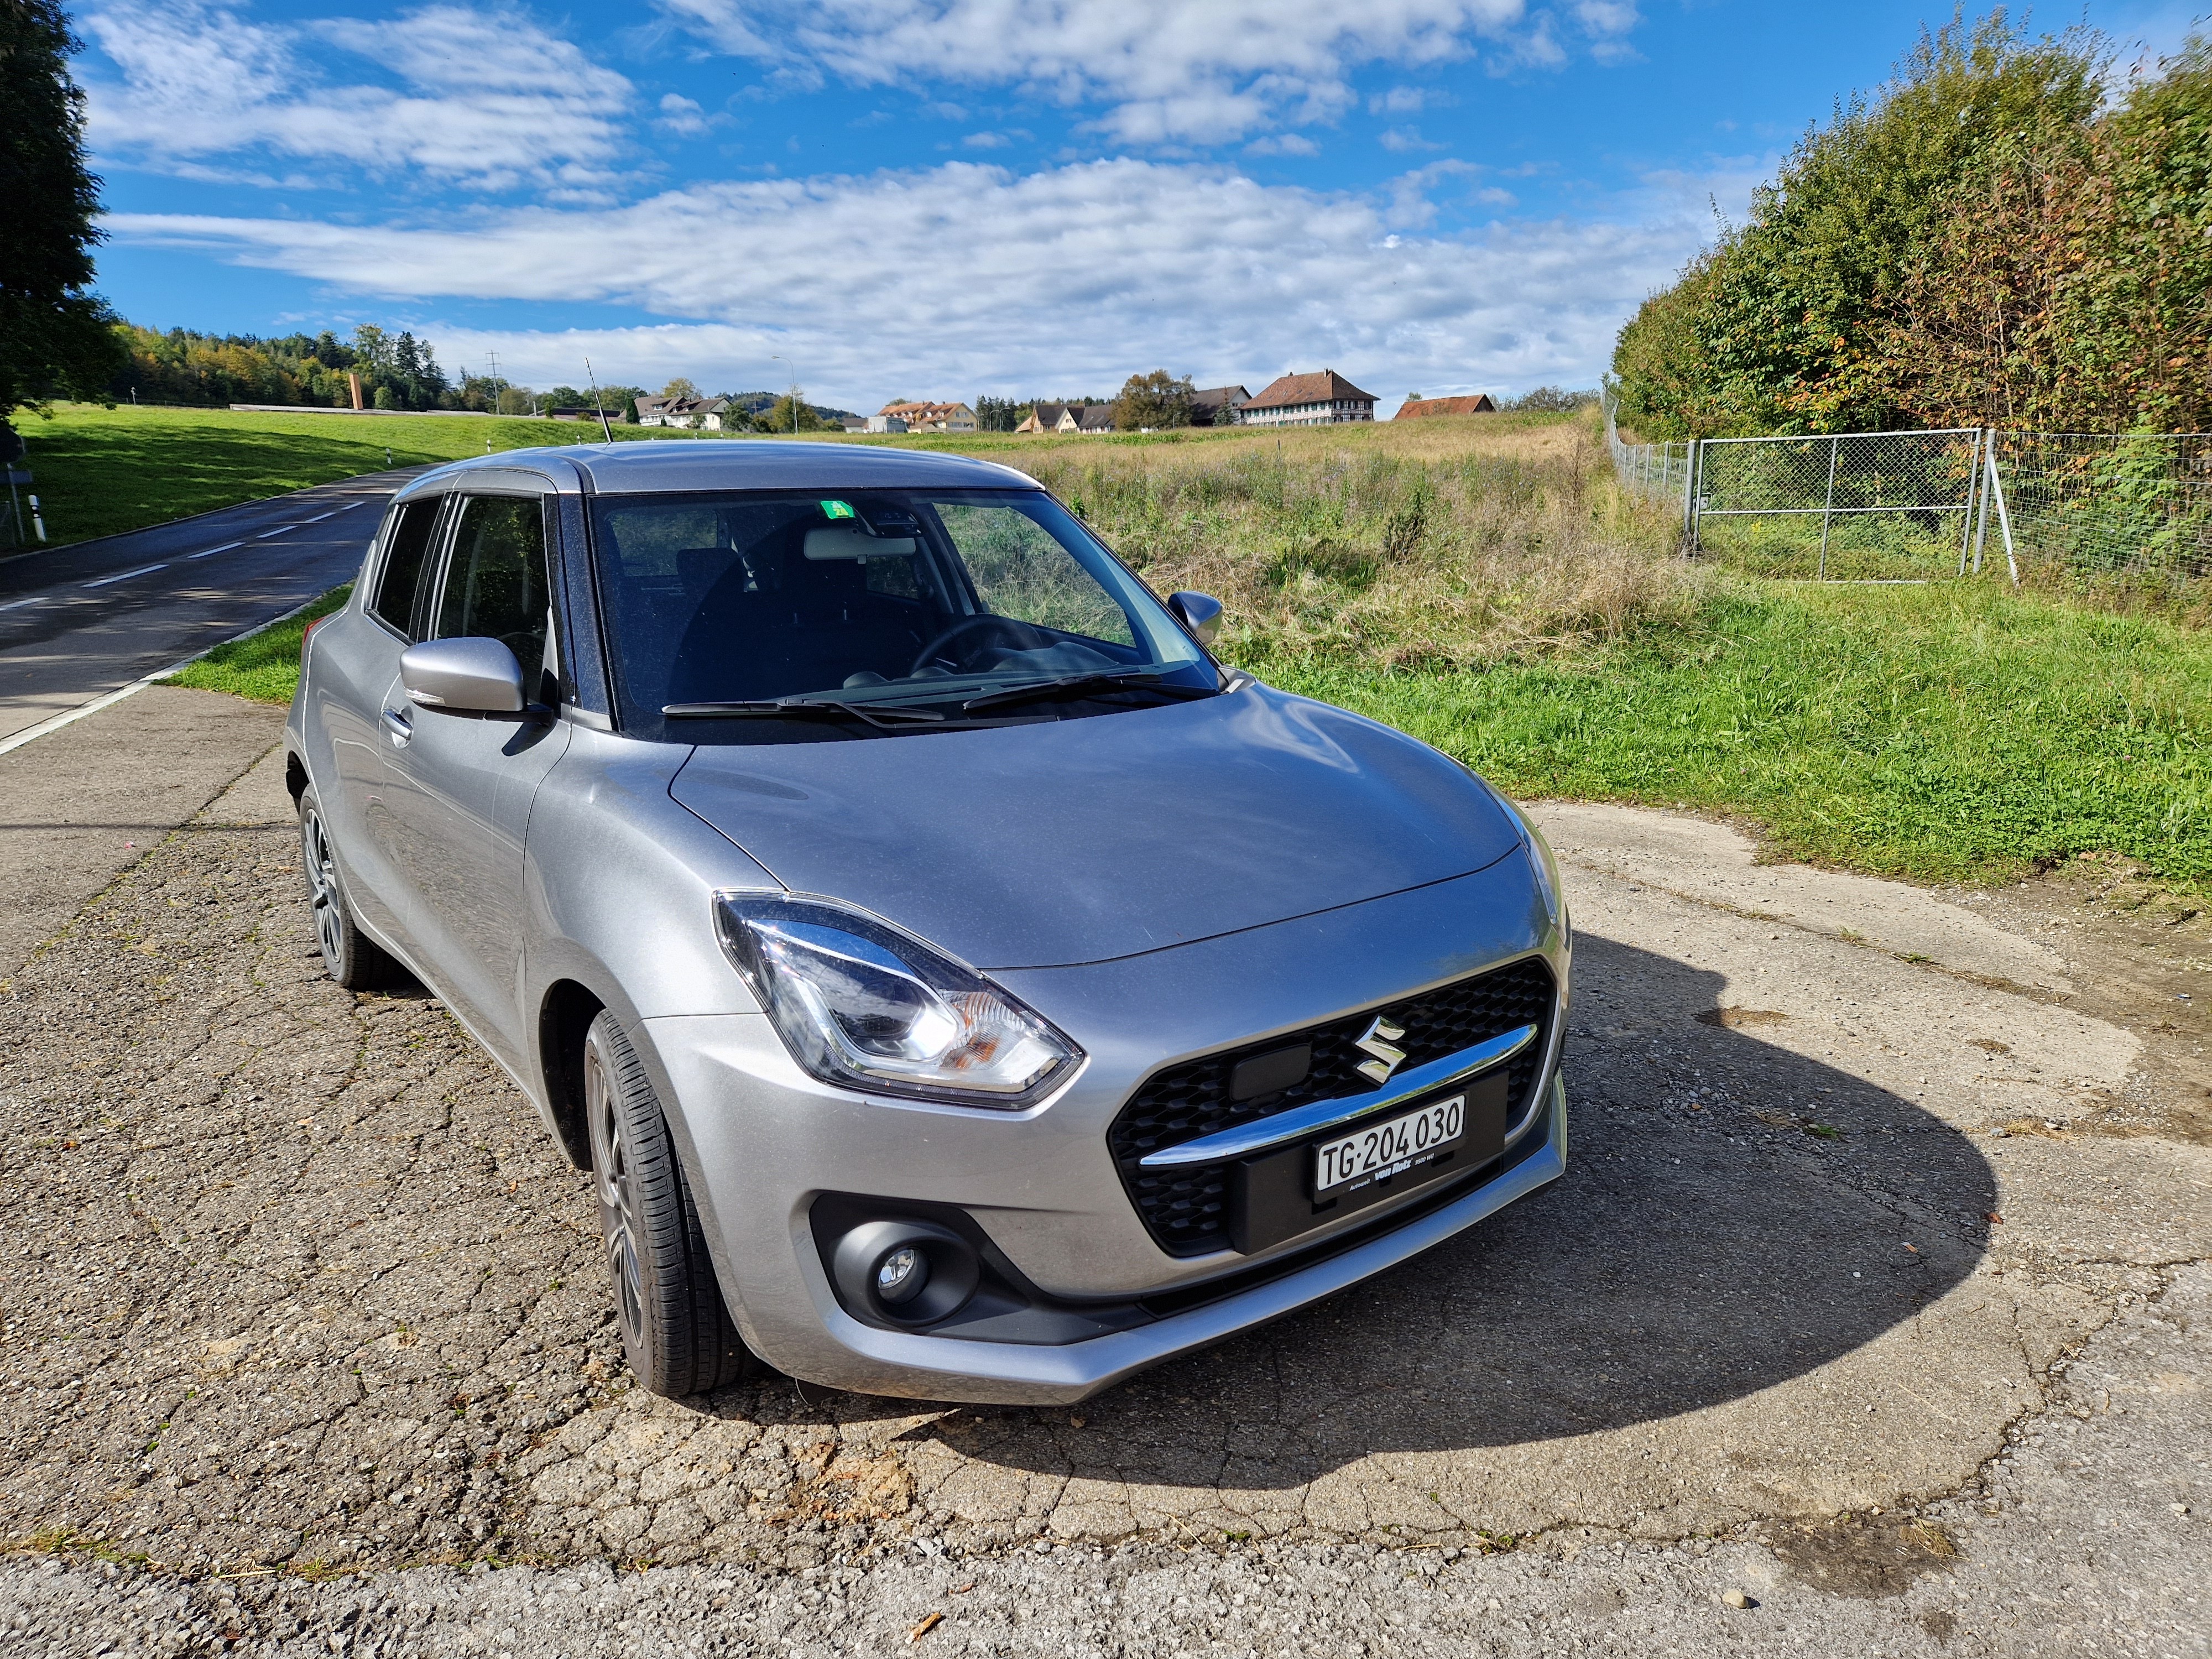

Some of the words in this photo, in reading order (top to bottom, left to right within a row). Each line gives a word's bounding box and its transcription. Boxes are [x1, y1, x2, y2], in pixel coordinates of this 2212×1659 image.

[1416, 1103, 1459, 1149] 030
[1349, 1178, 1371, 1192] Autowelt
[1375, 1167, 1392, 1181] von
[1391, 1159, 1412, 1175] Rotz
